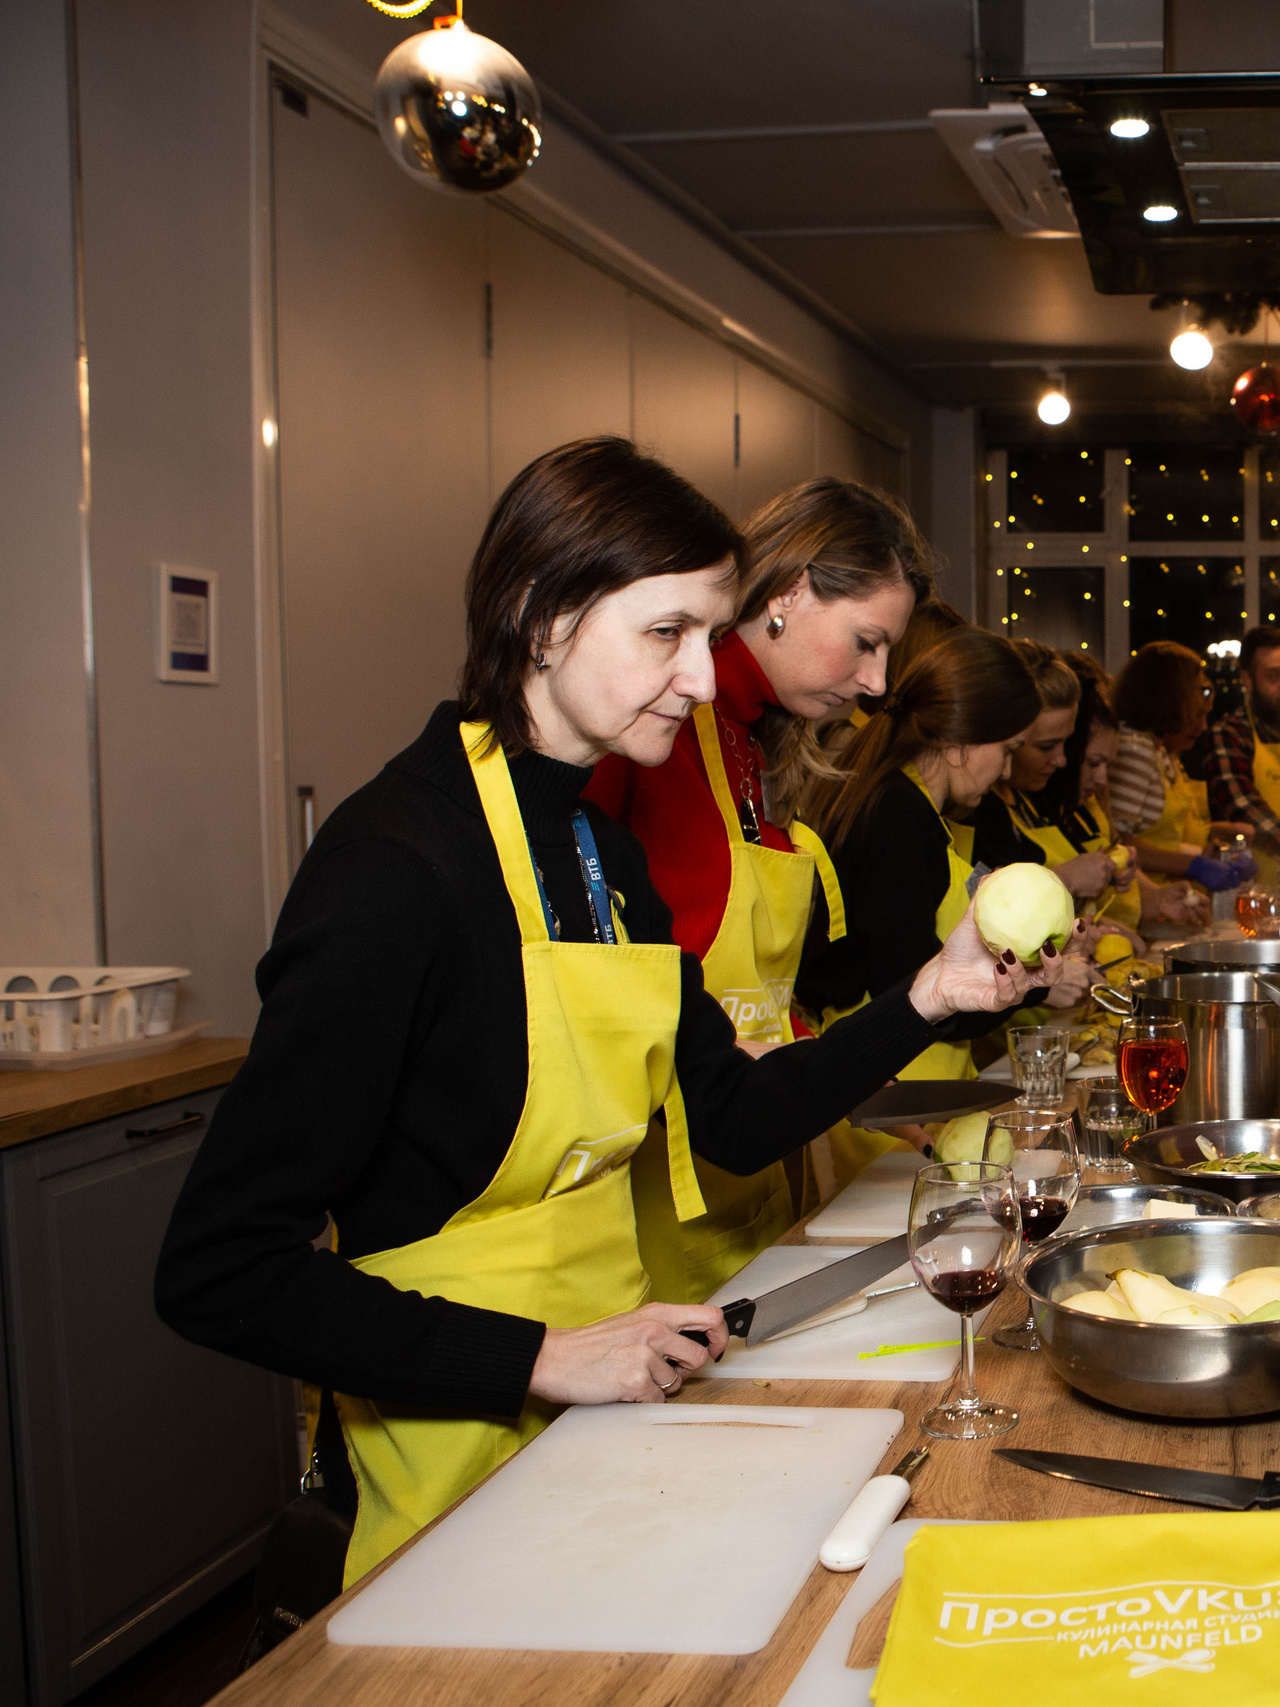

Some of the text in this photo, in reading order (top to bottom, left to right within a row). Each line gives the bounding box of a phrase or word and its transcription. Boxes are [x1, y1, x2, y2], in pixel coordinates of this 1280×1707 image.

[586, 857, 602, 881] ВТБ
[1056, 1617, 1199, 1643] КУЛИНАРНАЯ
[1078, 1623, 1263, 1659] MAUNFELD
